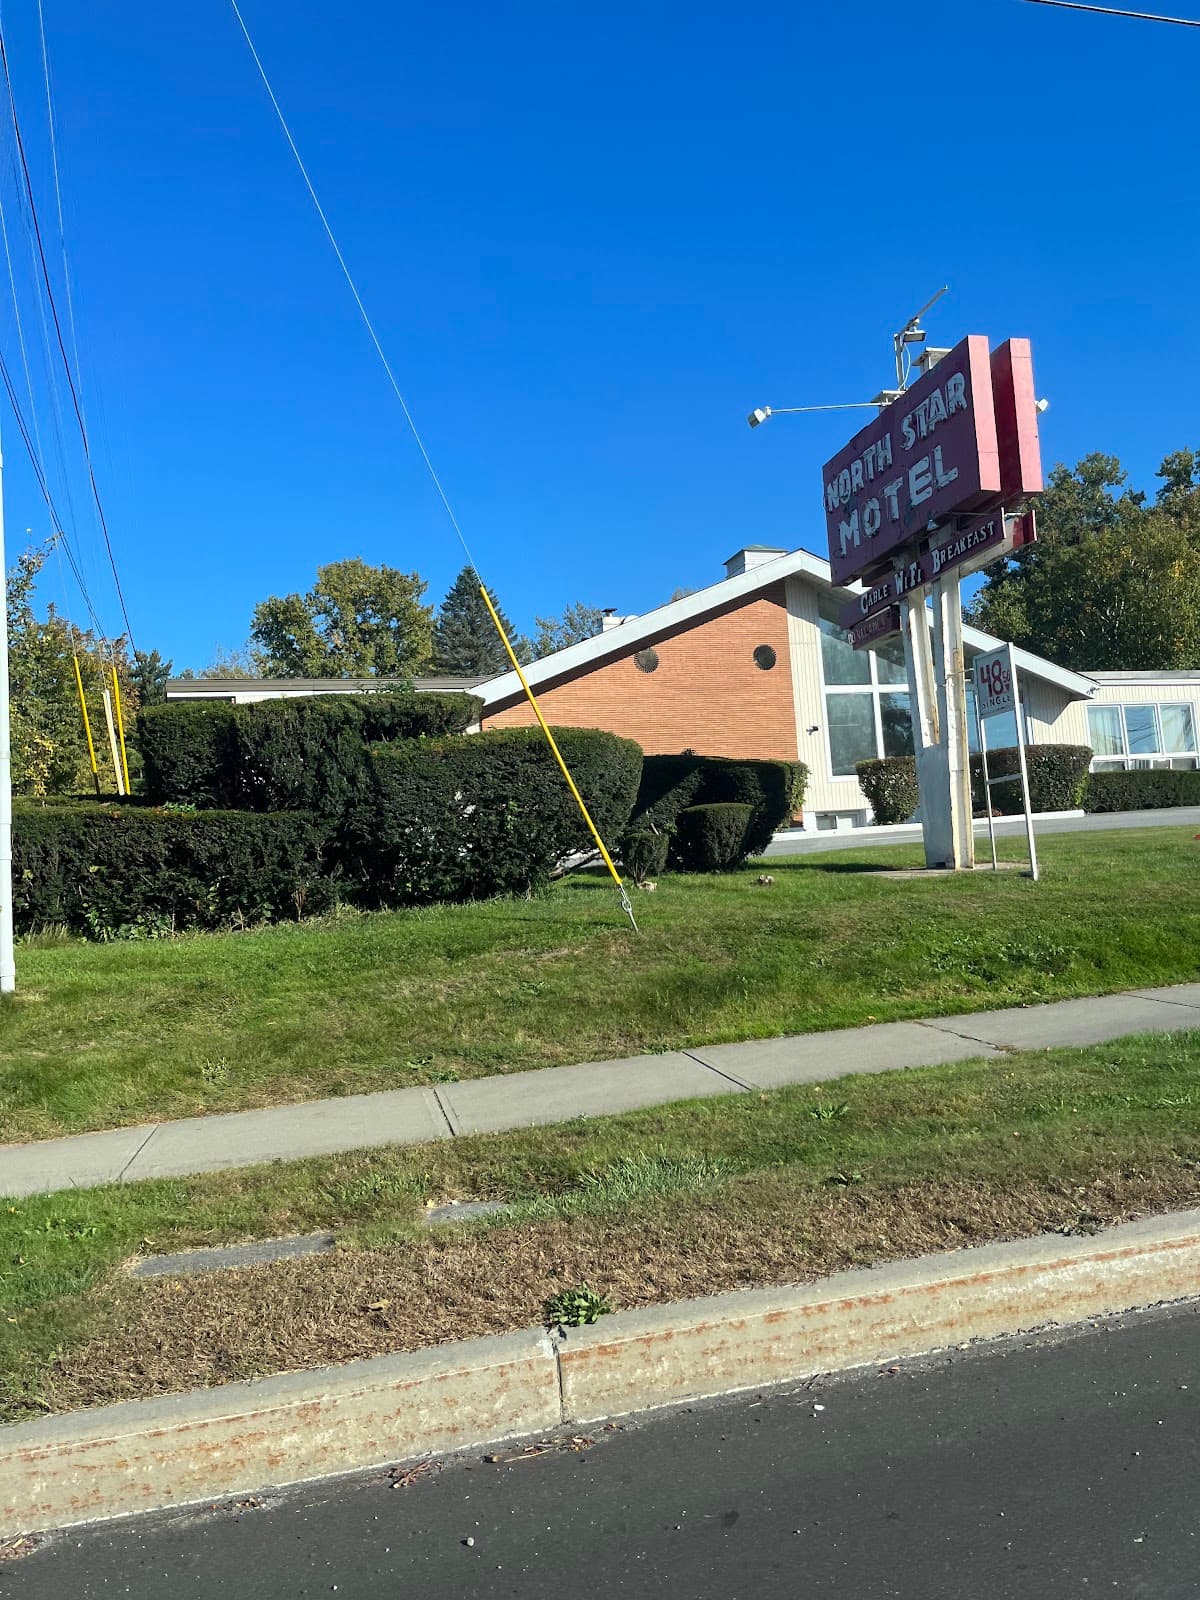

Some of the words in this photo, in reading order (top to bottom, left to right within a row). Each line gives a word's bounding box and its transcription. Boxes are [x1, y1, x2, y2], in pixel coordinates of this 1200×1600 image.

[825, 434, 892, 512] NORTH
[901, 373, 967, 450] STAR
[840, 446, 958, 557] MOTEL
[980, 660, 1003, 697] 48
